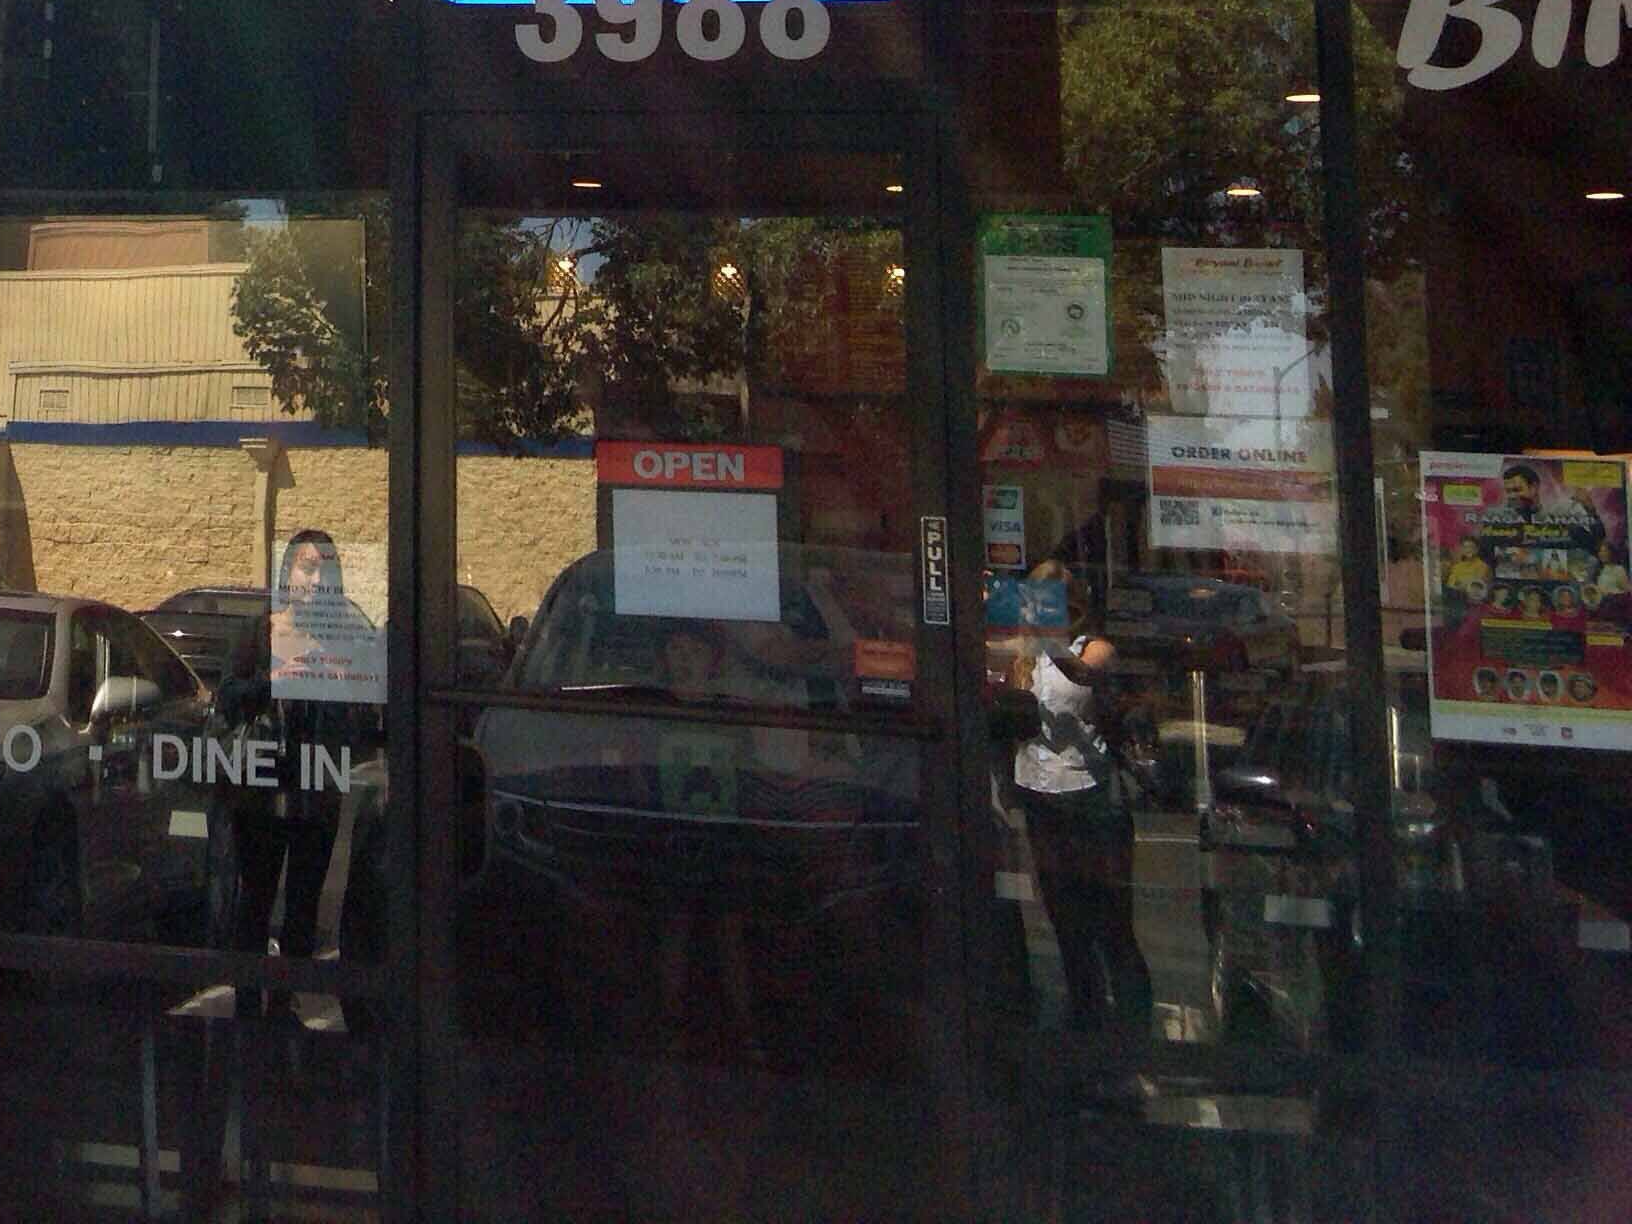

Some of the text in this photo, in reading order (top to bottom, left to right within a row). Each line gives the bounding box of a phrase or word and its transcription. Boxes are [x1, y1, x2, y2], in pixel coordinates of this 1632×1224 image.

[633, 450, 745, 482] OPEN
[1171, 446, 1308, 464] ORDER ONLINE
[927, 531, 943, 591] PULL
[153, 733, 281, 788] DINE
[300, 743, 351, 793] IN
